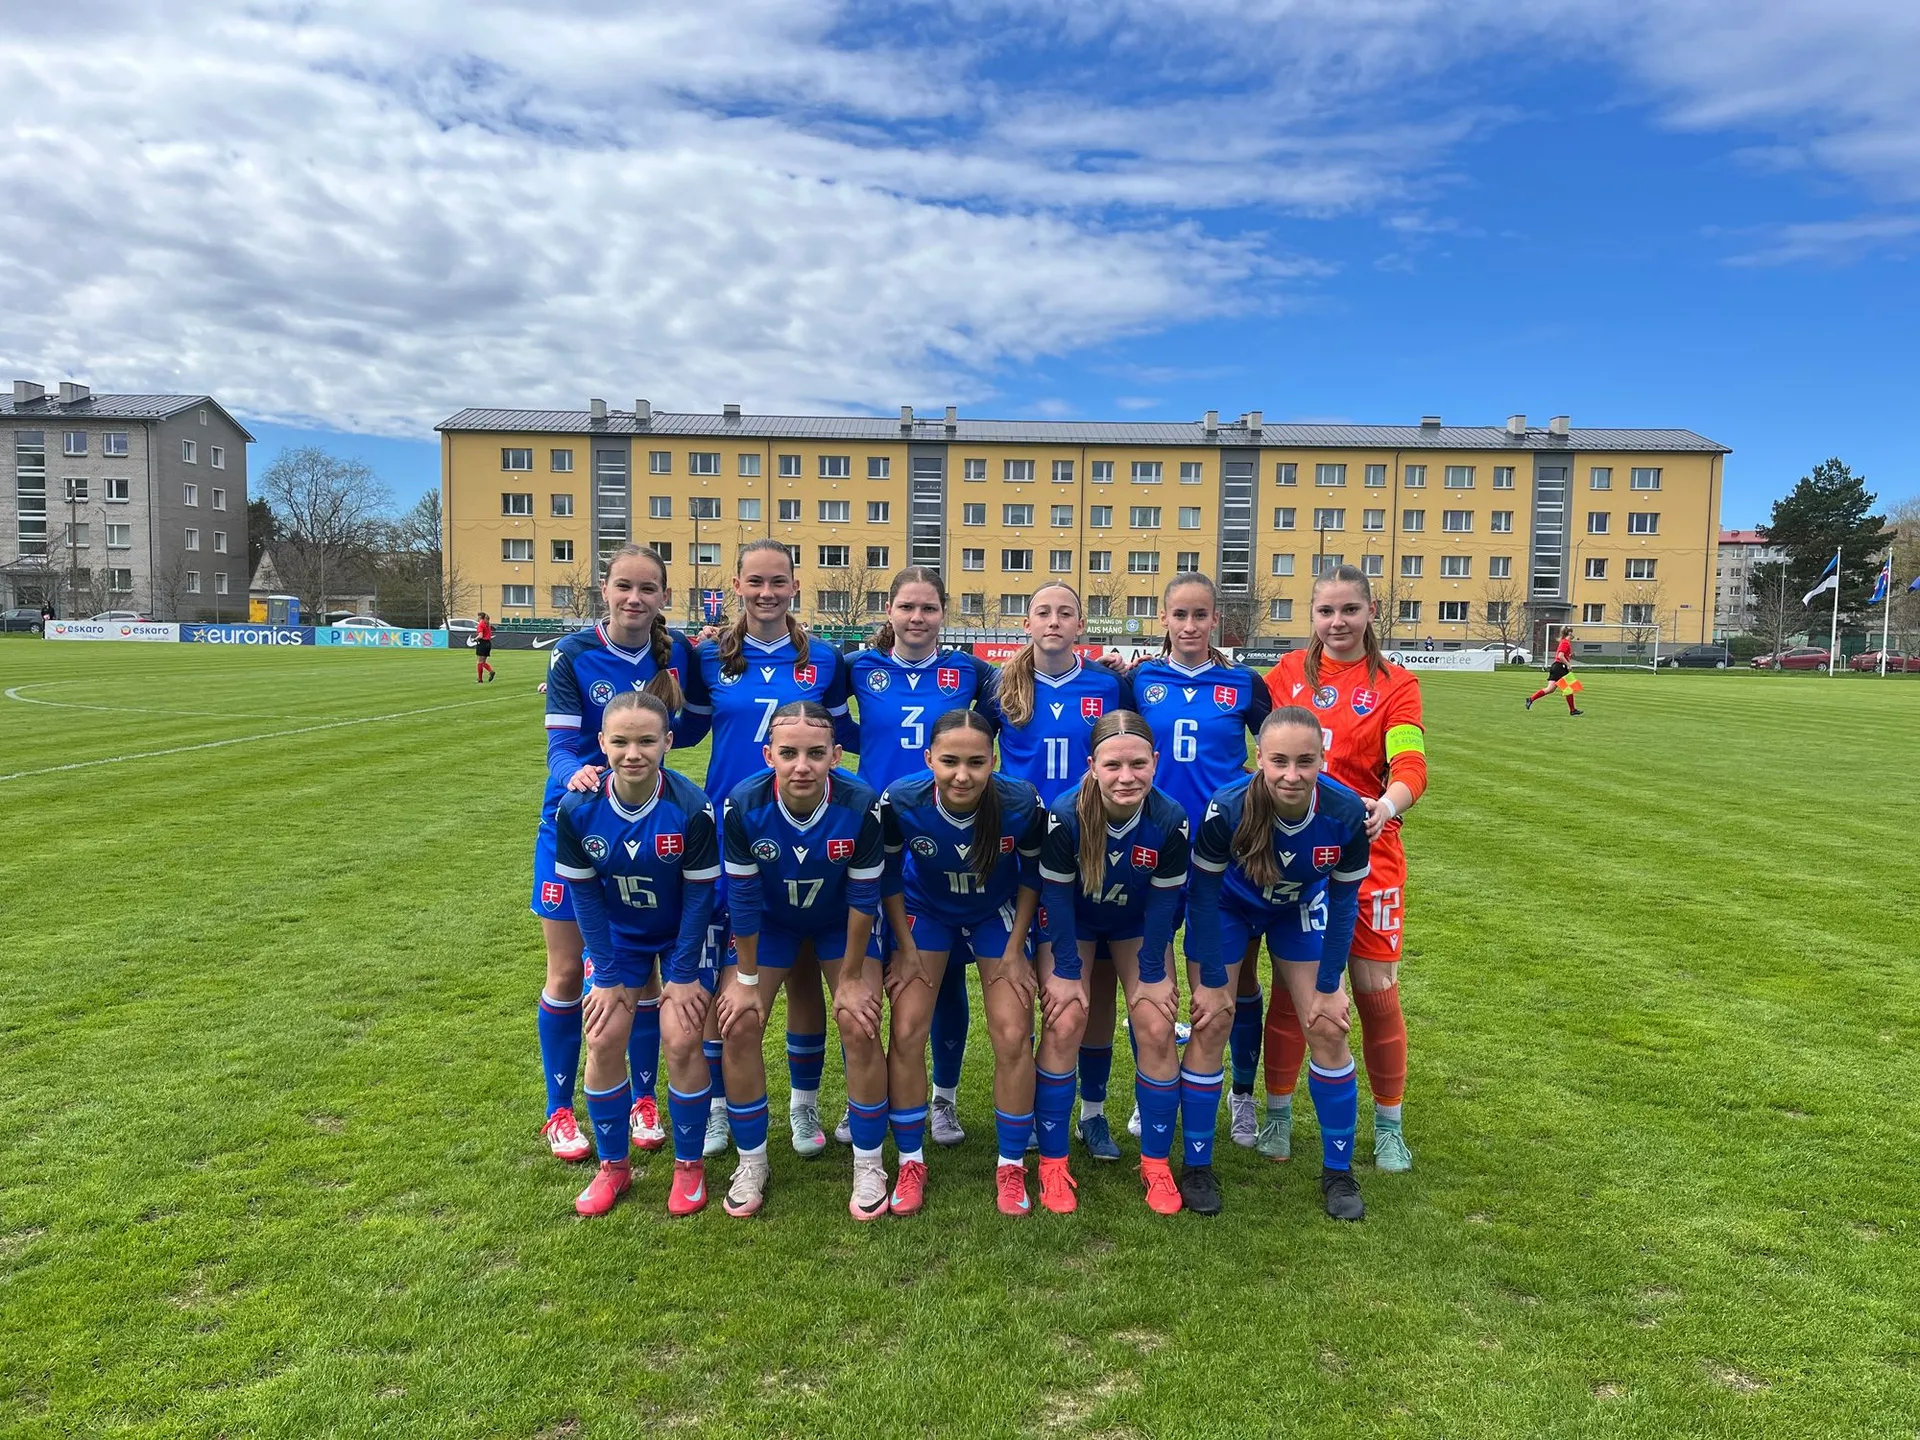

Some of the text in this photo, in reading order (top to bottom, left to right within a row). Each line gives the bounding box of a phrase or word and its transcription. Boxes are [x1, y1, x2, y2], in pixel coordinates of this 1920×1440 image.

[67, 624, 104, 634] eskaro
[133, 625, 169, 635] eskaro
[207, 626, 303, 646] euronics
[330, 630, 433, 646] PLAYMAKERS
[1087, 626, 1101, 634] AUS
[1404, 655, 1471, 665] soccernet.ee
[754, 698, 779, 743] 7
[900, 706, 925, 750] 3
[1173, 719, 1198, 762] 6
[1043, 737, 1069, 779] 11
[612, 874, 658, 909] 15
[783, 878, 824, 909] 17
[1370, 887, 1400, 931] 12
